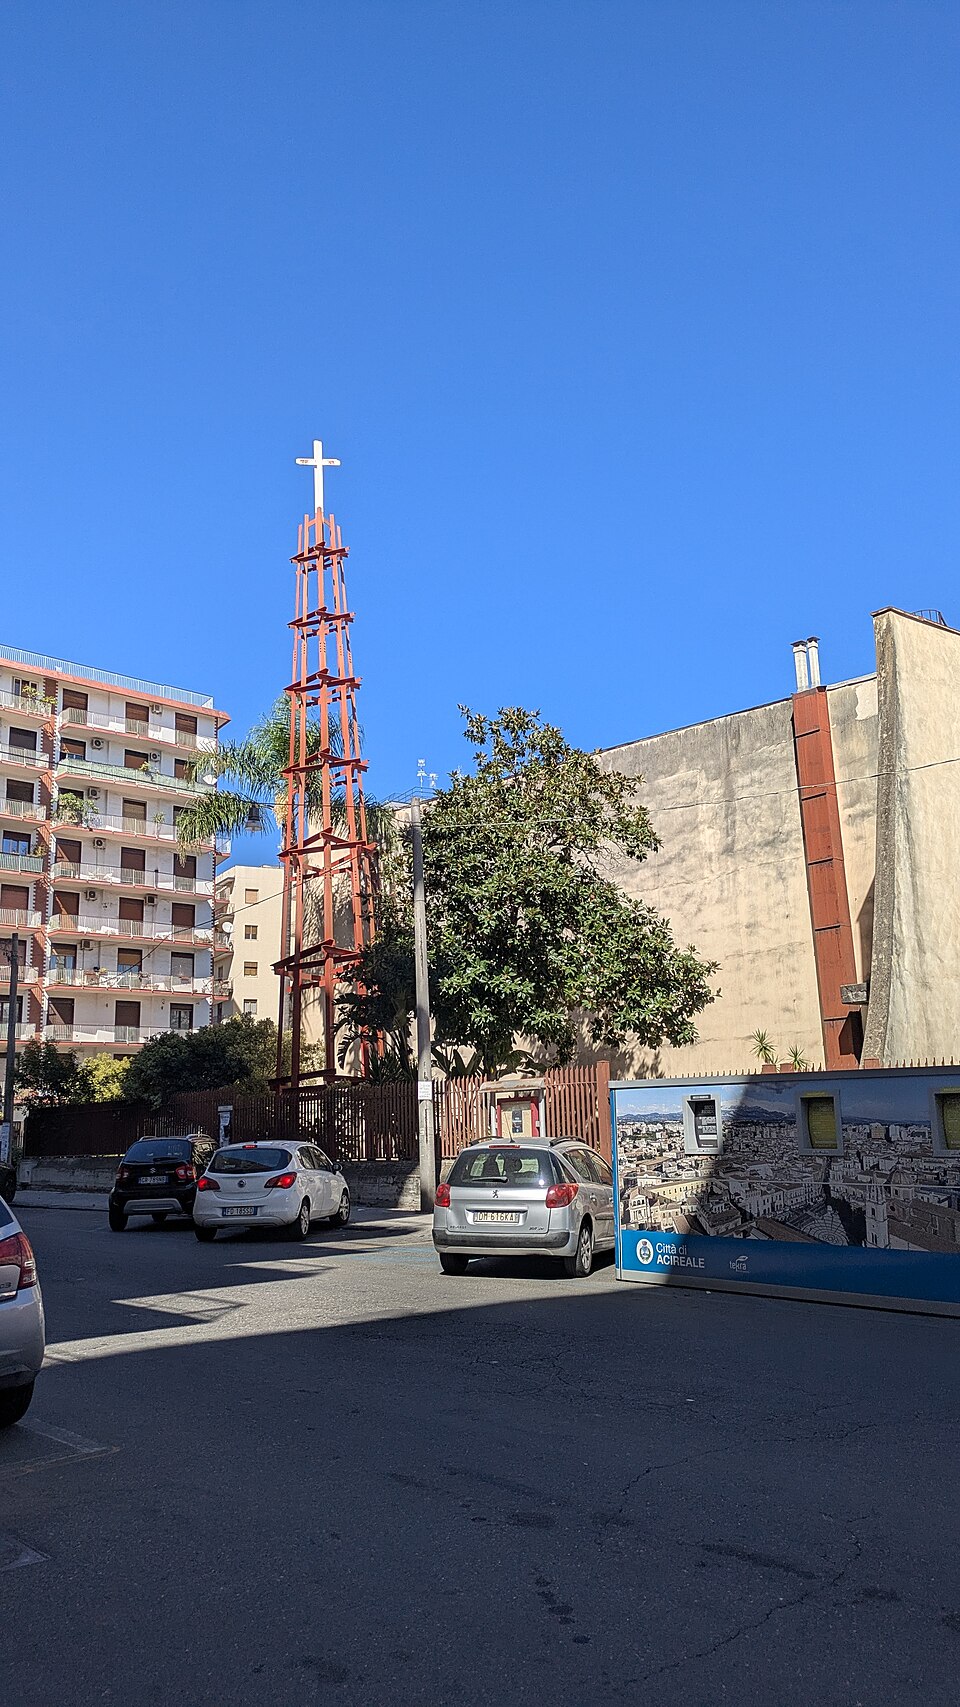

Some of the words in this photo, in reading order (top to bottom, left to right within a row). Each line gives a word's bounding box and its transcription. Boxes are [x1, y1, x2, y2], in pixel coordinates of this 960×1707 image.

[655, 1242, 677, 1255] Città
[678, 1245, 687, 1255] di
[656, 1255, 705, 1269] ACIREALE
